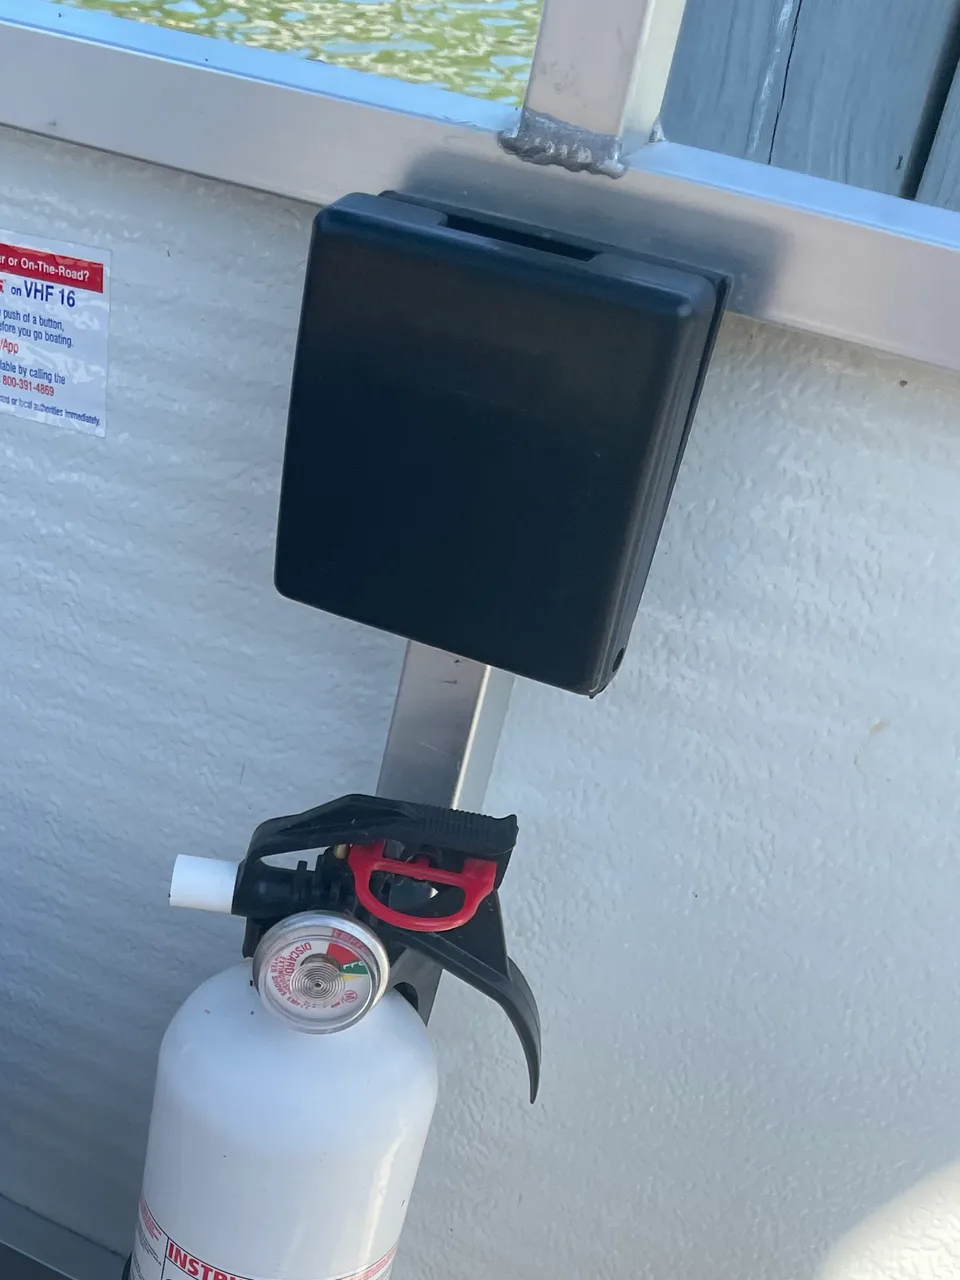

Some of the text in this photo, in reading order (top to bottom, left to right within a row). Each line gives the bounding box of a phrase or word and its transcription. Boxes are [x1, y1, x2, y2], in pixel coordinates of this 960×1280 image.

[8, 257, 18, 266] or
[21, 258, 89, 281] On-The-Road?
[11, 286, 22, 296] on
[24, 280, 54, 302] VHF
[59, 289, 75, 308] 16
[3, 309, 20, 320] push
[23, 313, 30, 323] of
[32, 316, 37, 325] a
[39, 315, 64, 332] button,
[18, 327, 32, 338] you
[33, 331, 43, 341] go
[45, 332, 74, 348] boating.
[3, 375, 55, 397] 800-391-4869
[18, 366, 28, 378] by
[29, 368, 52, 384] calling
[54, 373, 66, 385] the
[18, 398, 32, 410] local
[33, 402, 63, 417] authorities
